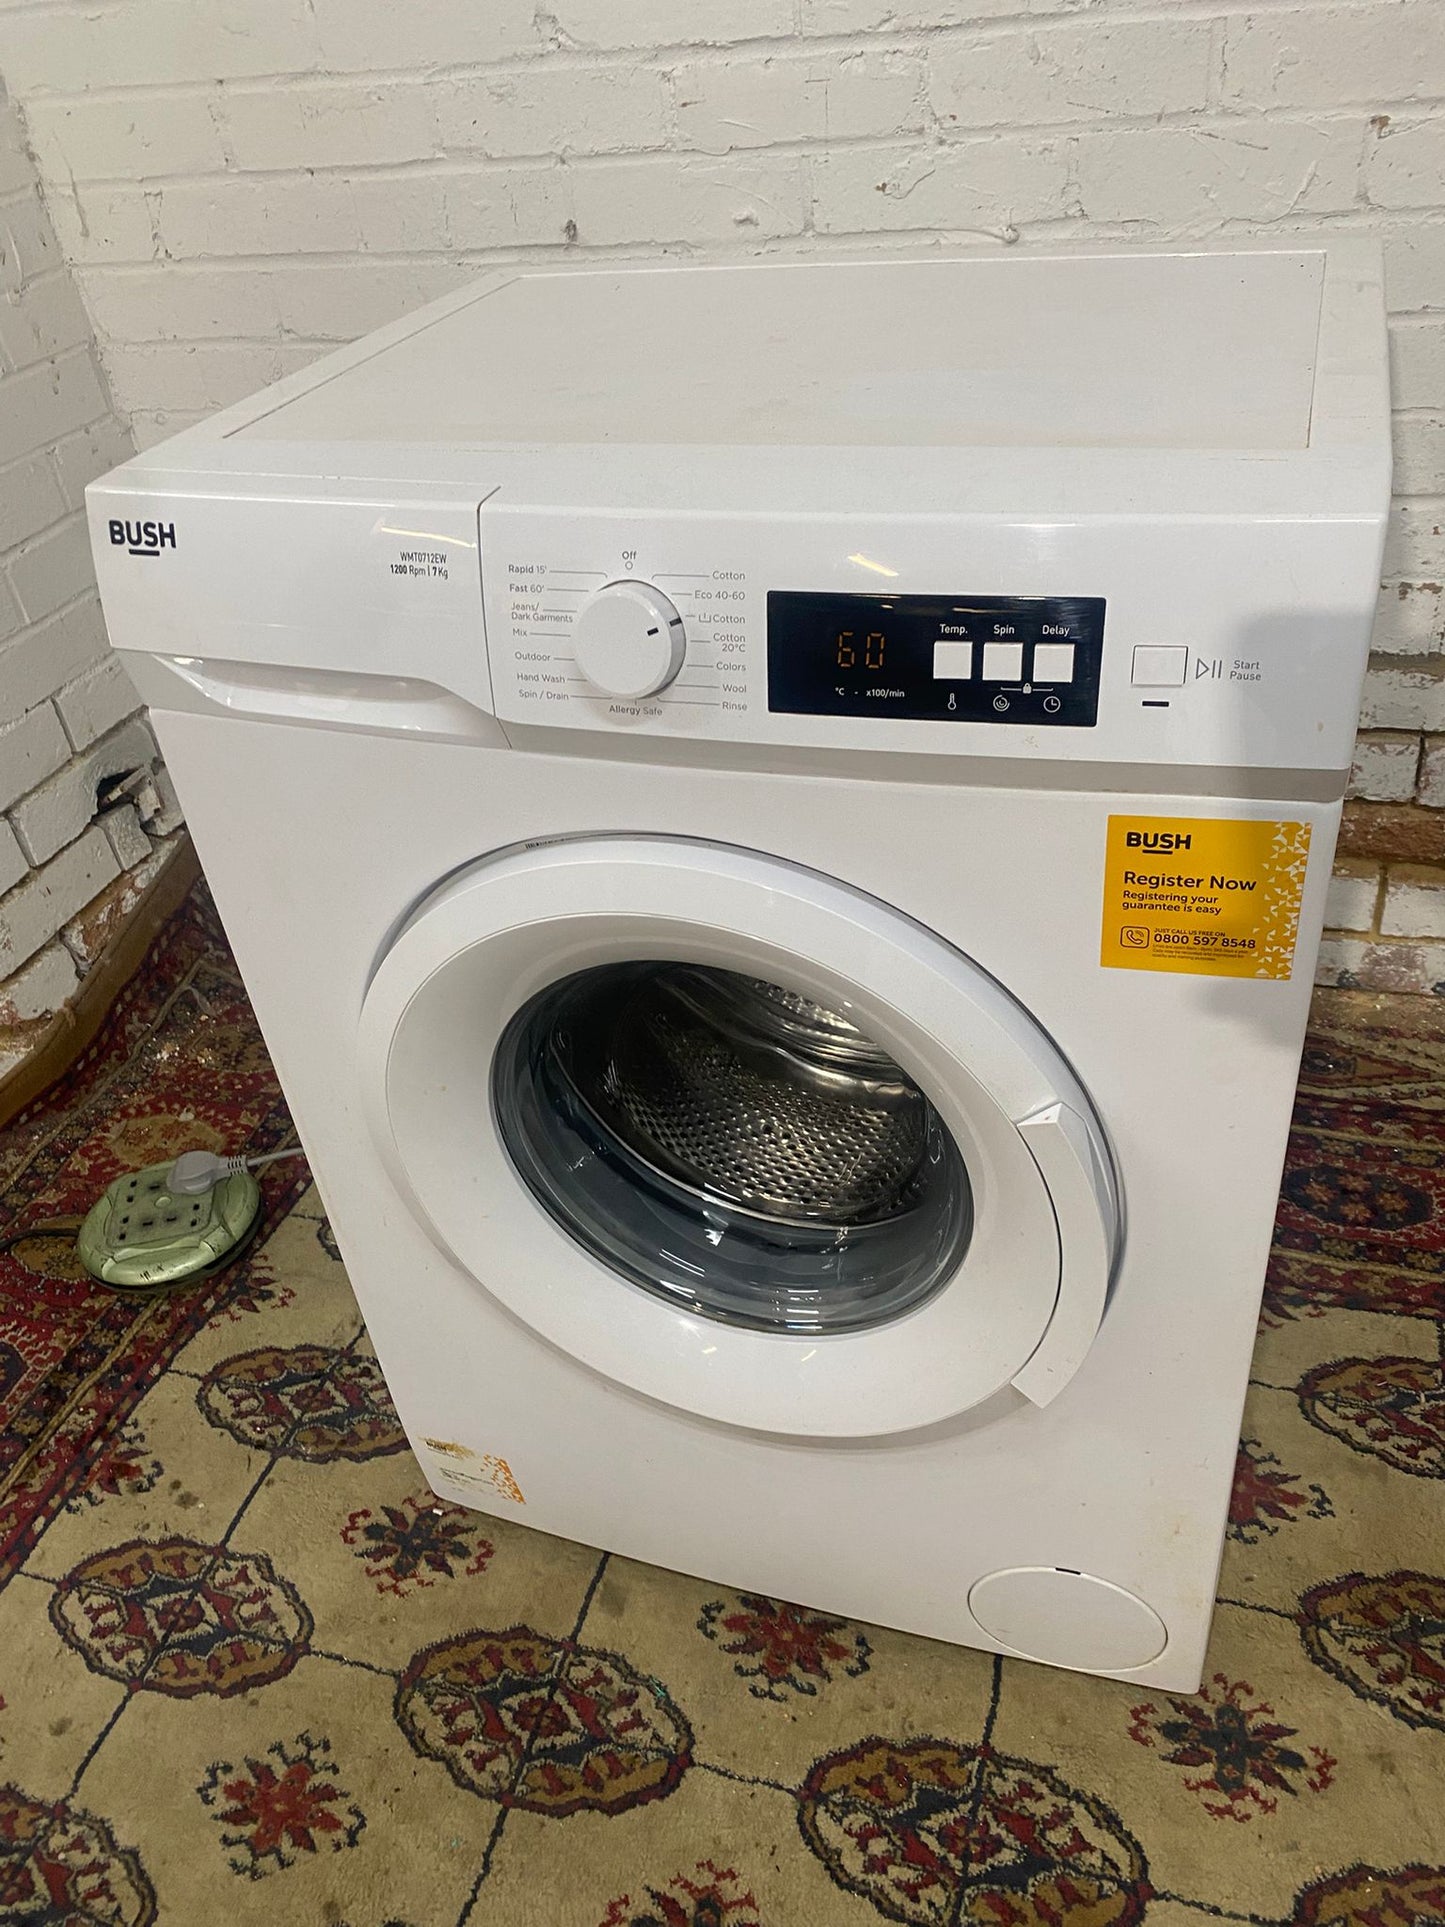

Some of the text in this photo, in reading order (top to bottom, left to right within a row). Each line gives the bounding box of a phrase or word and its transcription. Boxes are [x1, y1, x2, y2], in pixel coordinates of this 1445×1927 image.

[108, 519, 177, 549] BUSH
[399, 551, 447, 564] WMT0712EW
[621, 551, 637, 561] Off
[390, 564, 448, 580] 1200 Rpm 7 Kg
[508, 564, 534, 574] Rapid
[712, 571, 746, 581] Cotton
[509, 583, 544, 593] Fast 60'
[694, 590, 746, 600] Eco 40-60
[511, 602, 540, 611] Jeans/
[511, 612, 573, 623] Dark Garments
[712, 614, 746, 624] Cotton
[512, 628, 528, 637] Mix
[939, 624, 968, 634] Temp.
[993, 625, 1015, 635] Spin
[1042, 625, 1070, 636] Delay
[713, 633, 746, 643] Cotton
[721, 643, 746, 653] 20°C
[837, 631, 885, 669] 60
[514, 651, 551, 661] Outdoor
[716, 661, 747, 671] Colors
[1233, 660, 1260, 670] Start
[516, 673, 566, 684] Hand Wash
[1229, 671, 1262, 681] Pause
[722, 684, 747, 693] Wool
[518, 689, 538, 699] Spin
[546, 691, 569, 701] Drain
[866, 689, 905, 699] x100/min
[609, 705, 663, 716] Allergy Safe
[722, 701, 748, 711] Rinse
[1126, 831, 1192, 850] BUSH
[1123, 871, 1257, 891] Register Now
[1123, 890, 1219, 904] Registering your
[1122, 901, 1222, 916] guarantee is easy
[1154, 933, 1190, 944] 0800
[1193, 936, 1219, 946] 597
[1221, 937, 1256, 949] 8548
